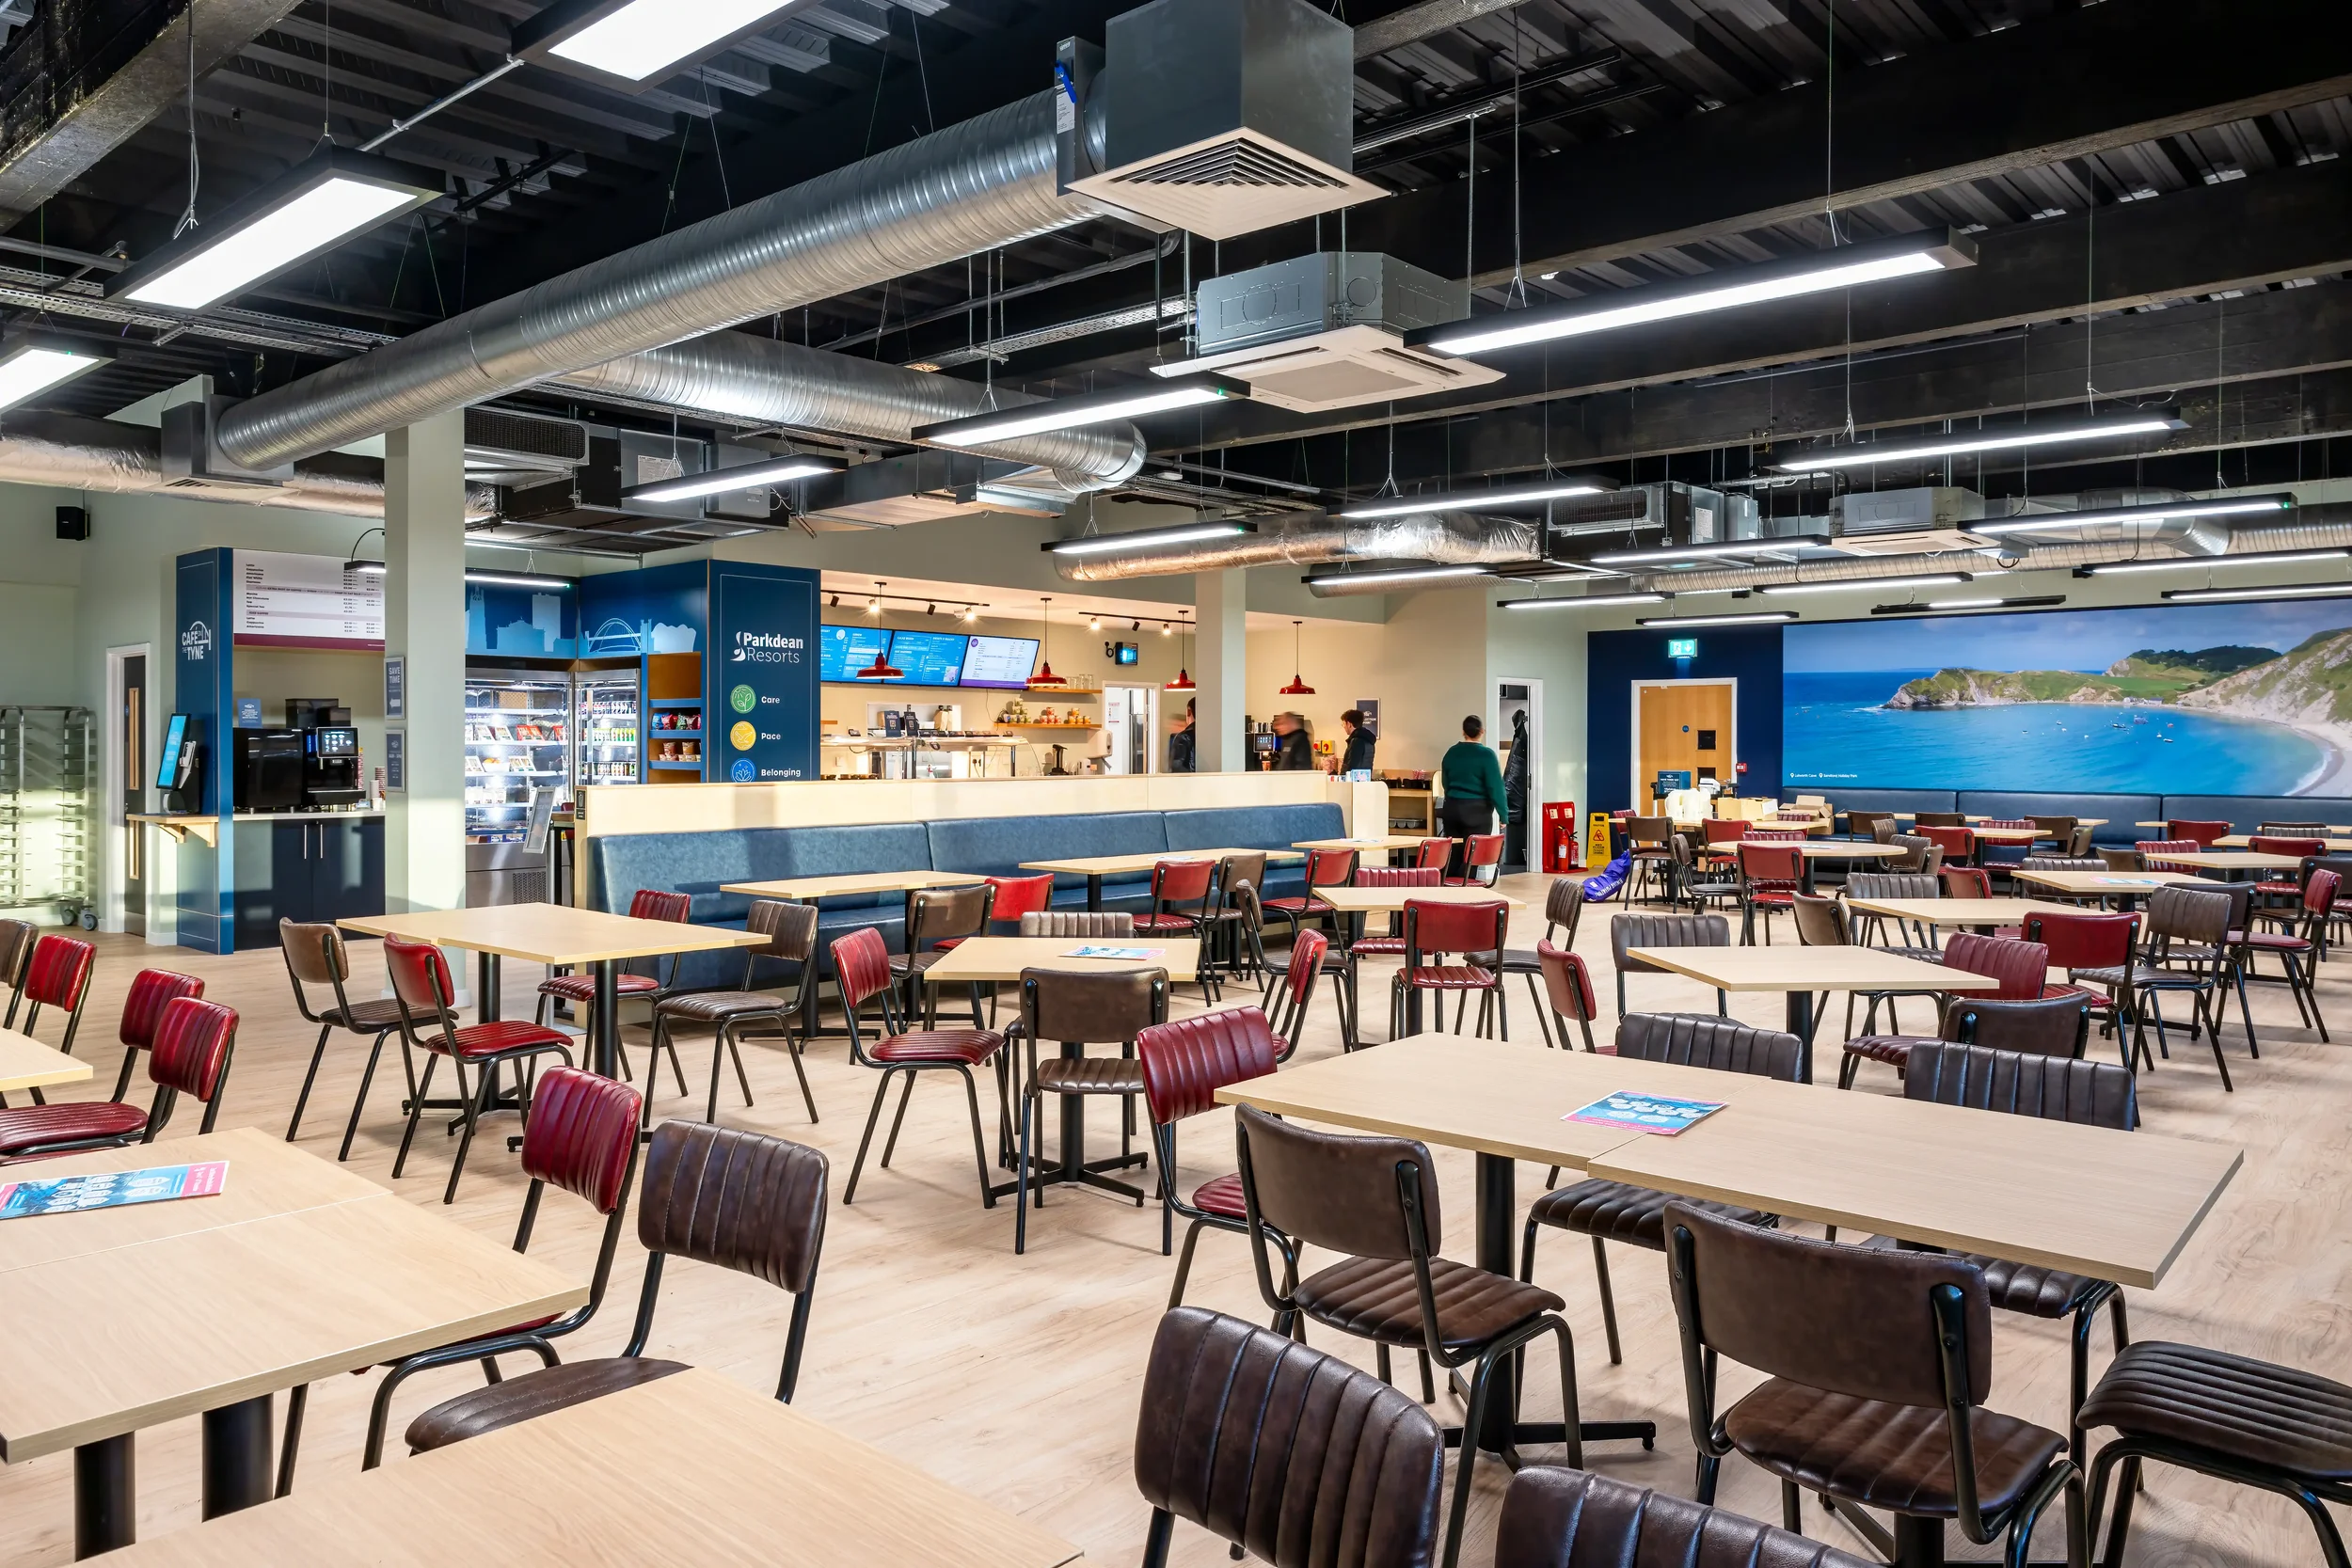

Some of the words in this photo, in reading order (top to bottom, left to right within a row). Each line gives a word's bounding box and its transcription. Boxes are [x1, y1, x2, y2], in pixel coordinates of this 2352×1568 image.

[183, 626, 199, 646] CAFÉ
[743, 632, 803, 649] Parkdean
[187, 645, 204, 661] TYNE
[747, 647, 800, 664] Resorts
[389, 667, 401, 675] SAVE
[389, 675, 401, 684] TIME
[761, 732, 782, 740] Pace
[761, 768, 802, 778] Belonging
